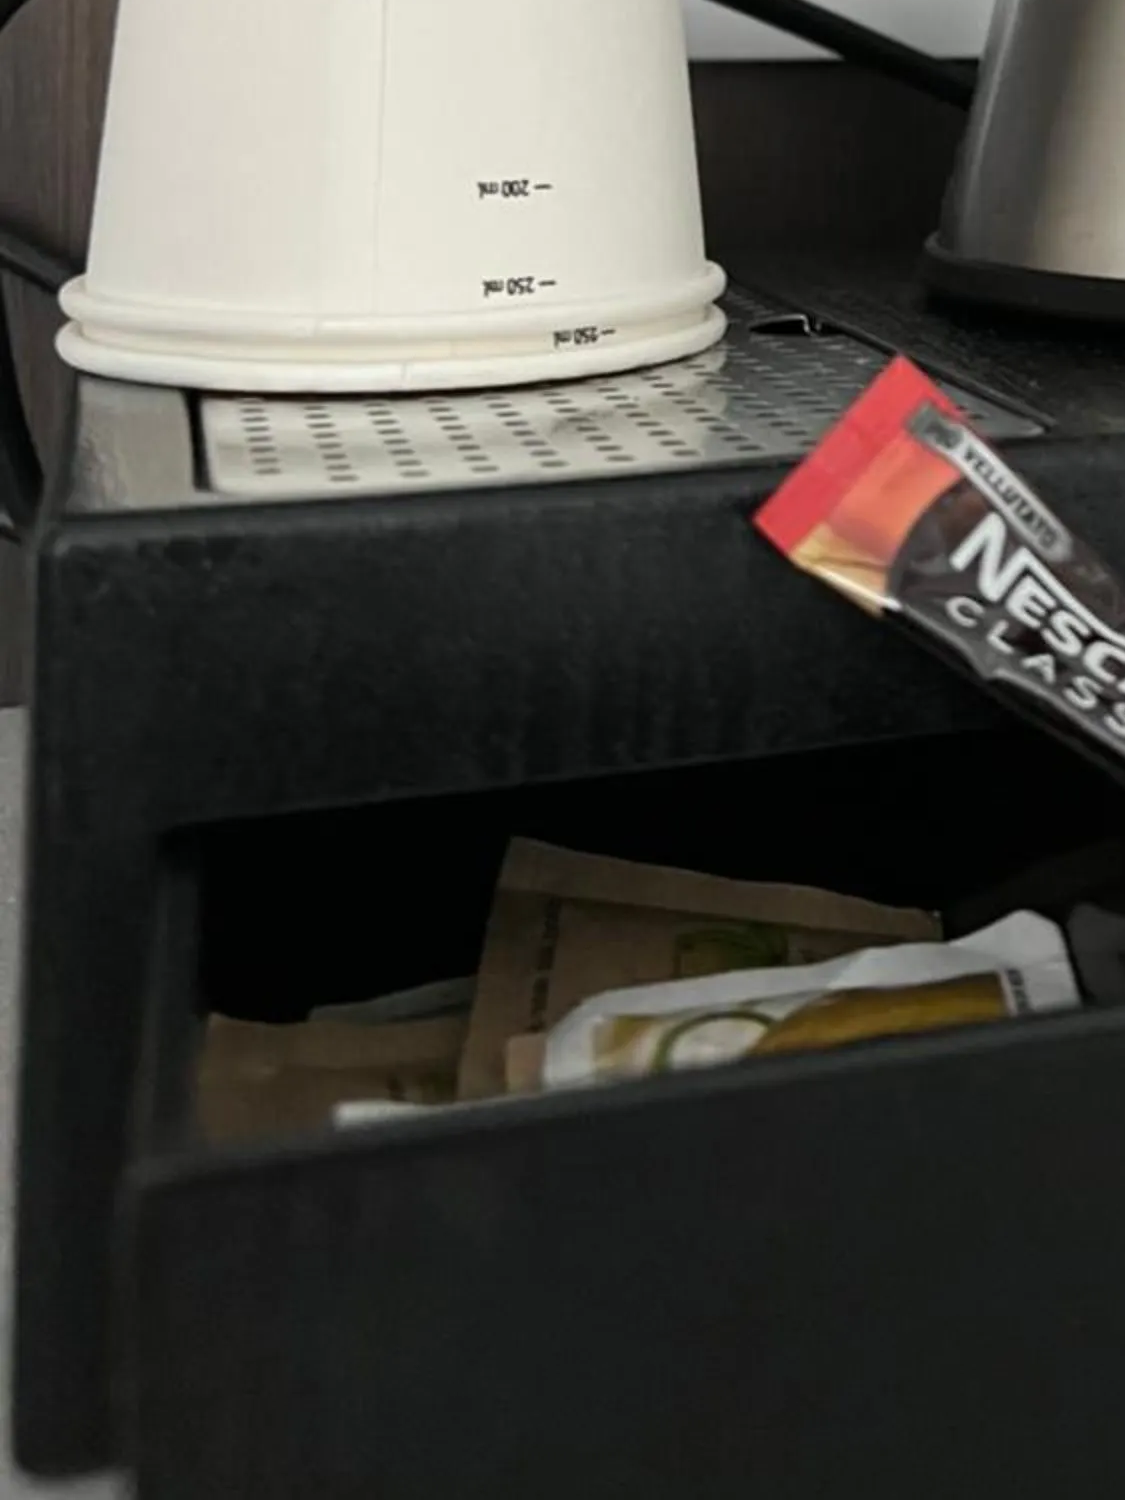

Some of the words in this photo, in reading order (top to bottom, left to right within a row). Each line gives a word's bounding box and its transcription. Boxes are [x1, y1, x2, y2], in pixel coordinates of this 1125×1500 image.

[501, 179, 530, 198] 200
[507, 276, 535, 295] 250
[573, 326, 599, 345] 250
[963, 445, 1058, 549] VELLUTATO
